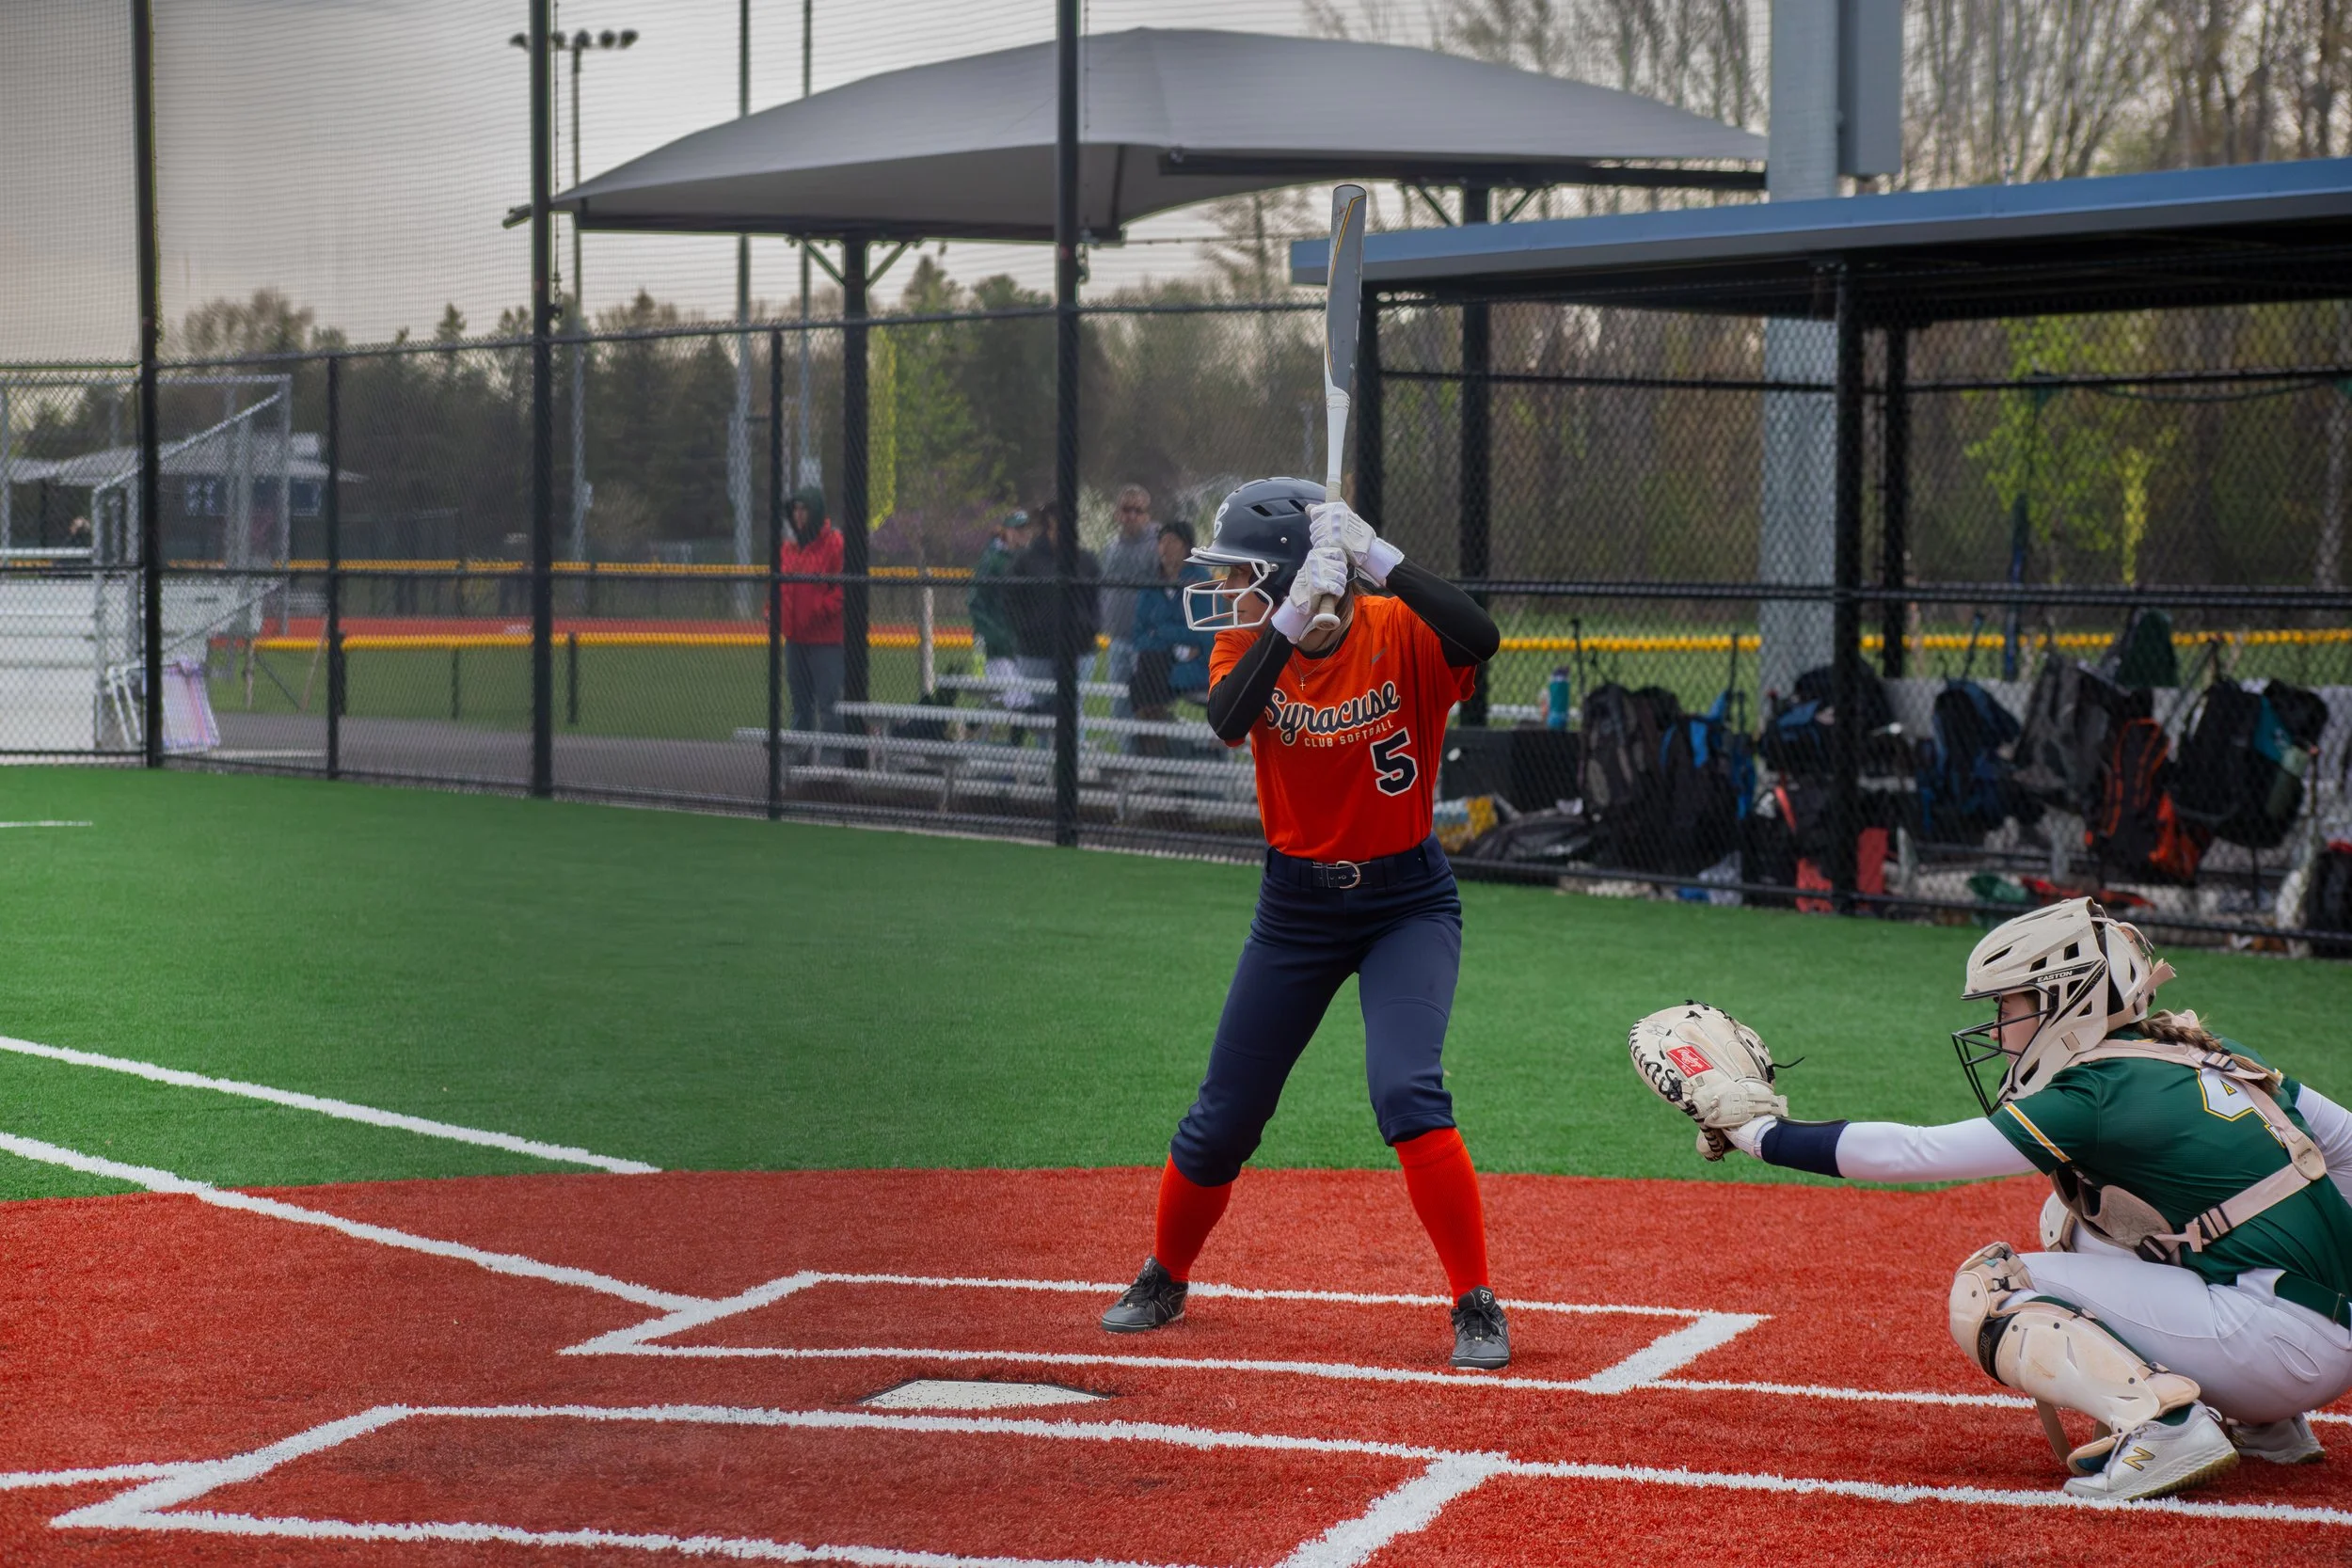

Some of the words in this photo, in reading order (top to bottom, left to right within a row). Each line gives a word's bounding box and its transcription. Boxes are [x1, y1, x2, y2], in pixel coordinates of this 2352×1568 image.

[1264, 680, 1401, 746] Syracuse
[1304, 737, 1333, 748] CLUB
[1340, 720, 1394, 745] SOFTBALL
[1369, 726, 1419, 797] 5
[2037, 970, 2073, 983] EASTON
